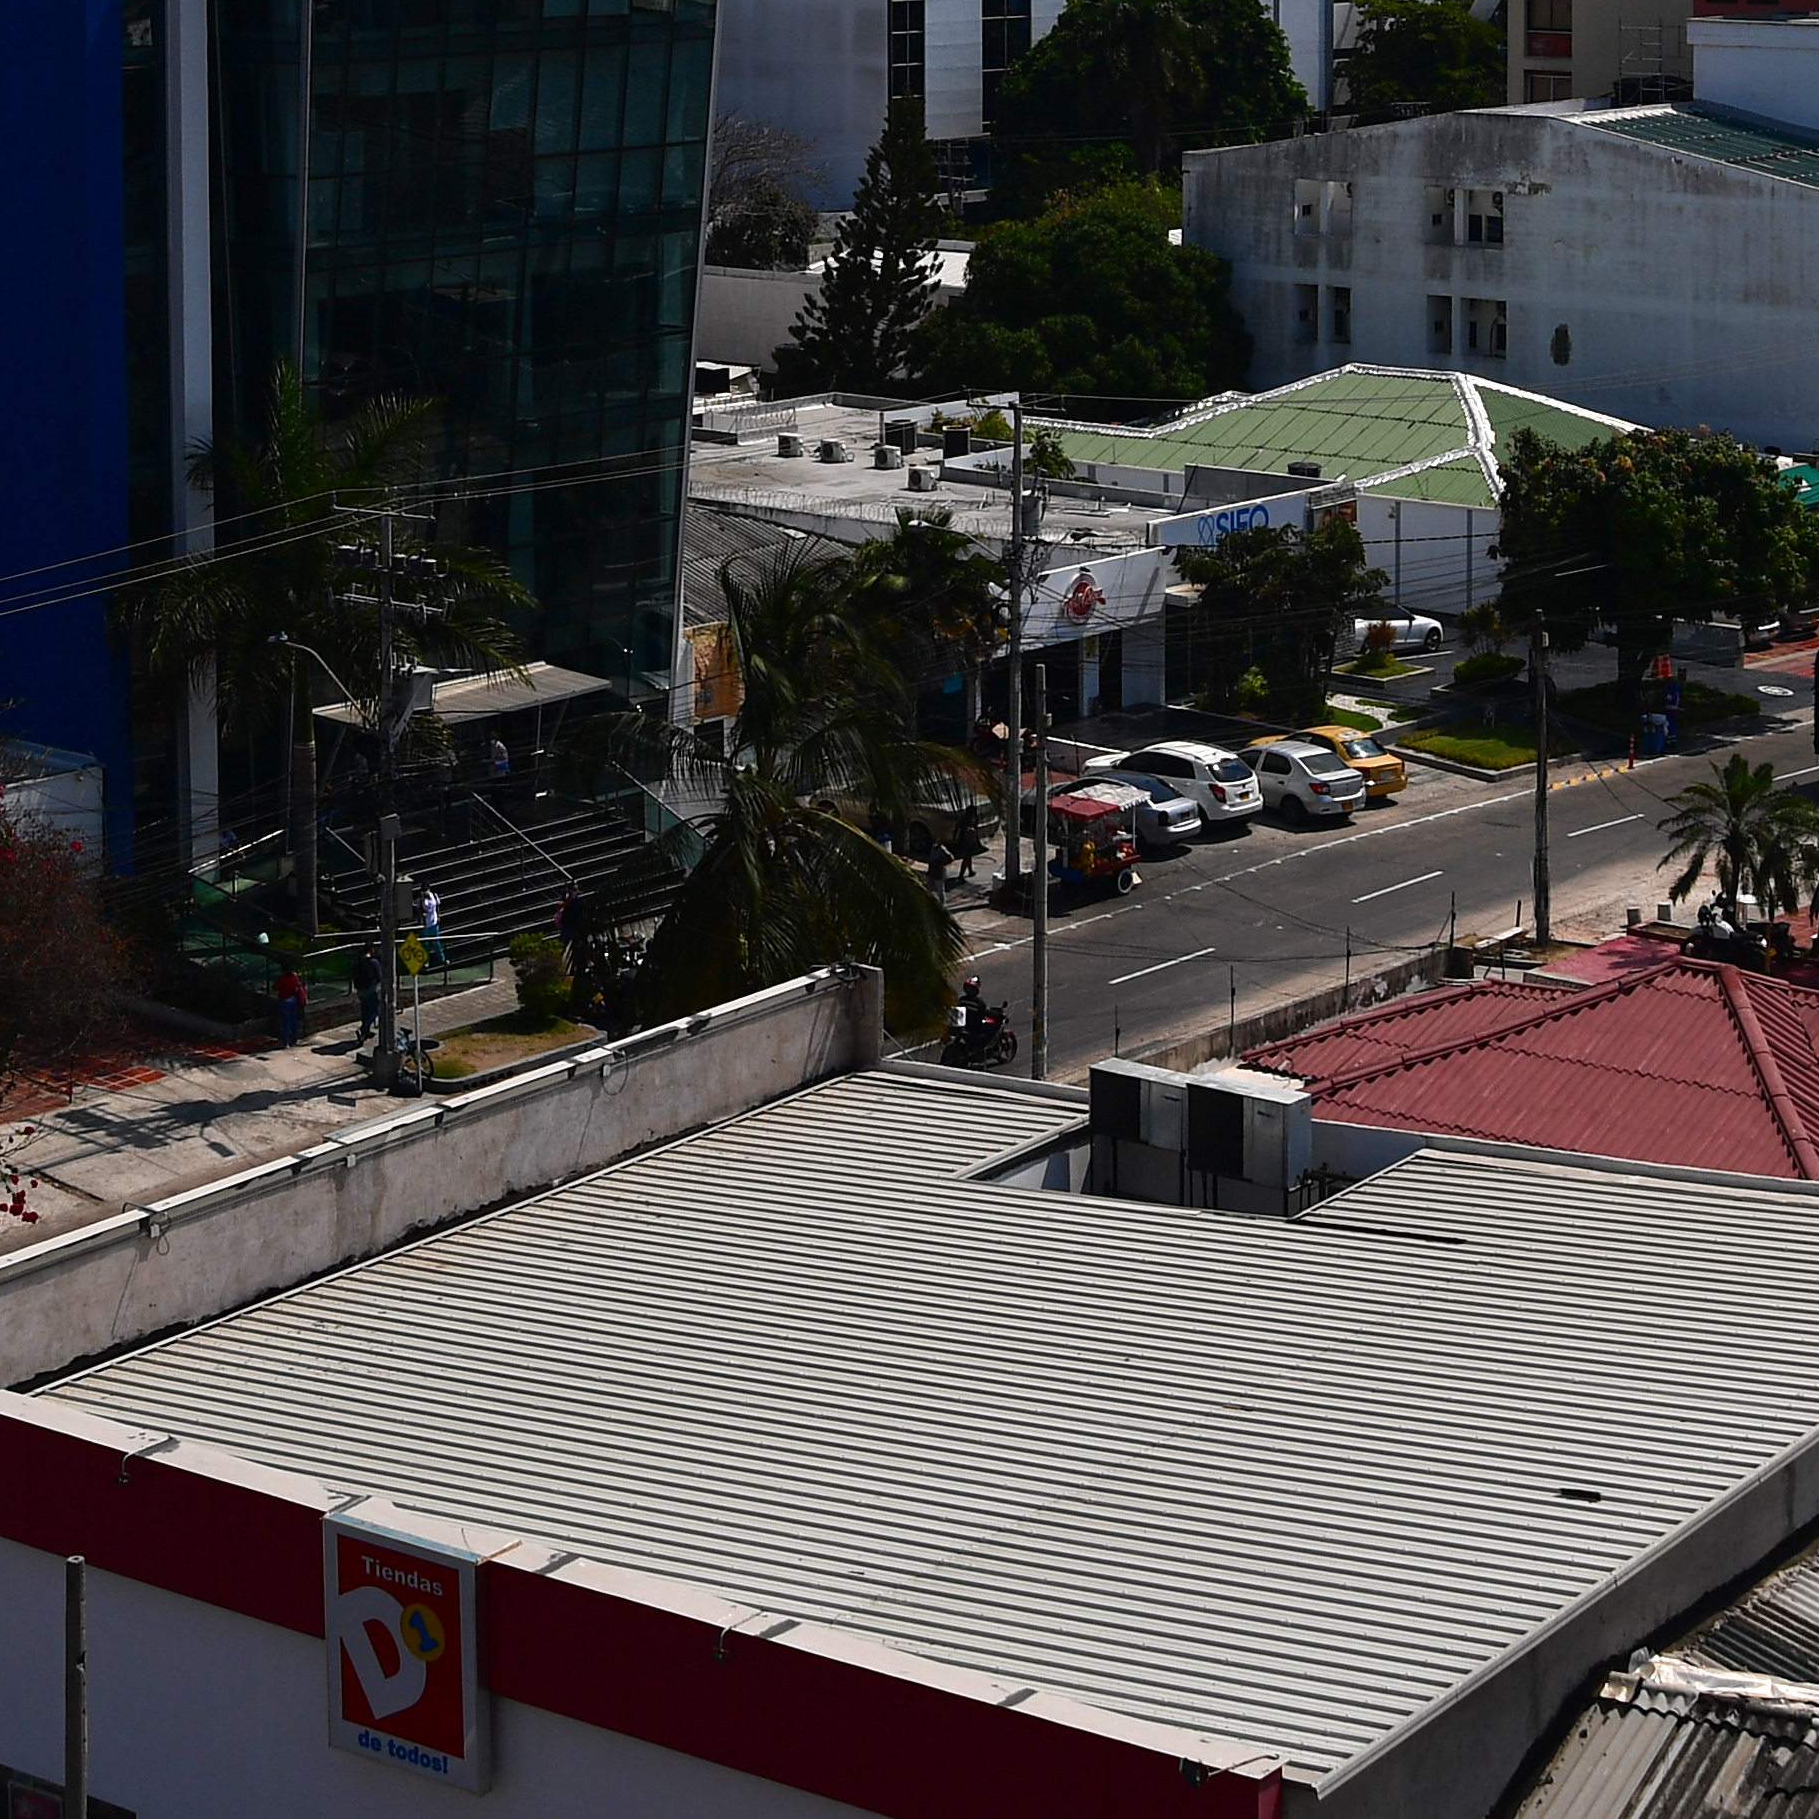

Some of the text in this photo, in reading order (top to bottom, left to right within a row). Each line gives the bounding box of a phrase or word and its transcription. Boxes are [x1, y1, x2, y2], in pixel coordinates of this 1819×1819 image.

[361, 1555, 444, 1597] Tiendas
[358, 1730, 449, 1774] de todos!
